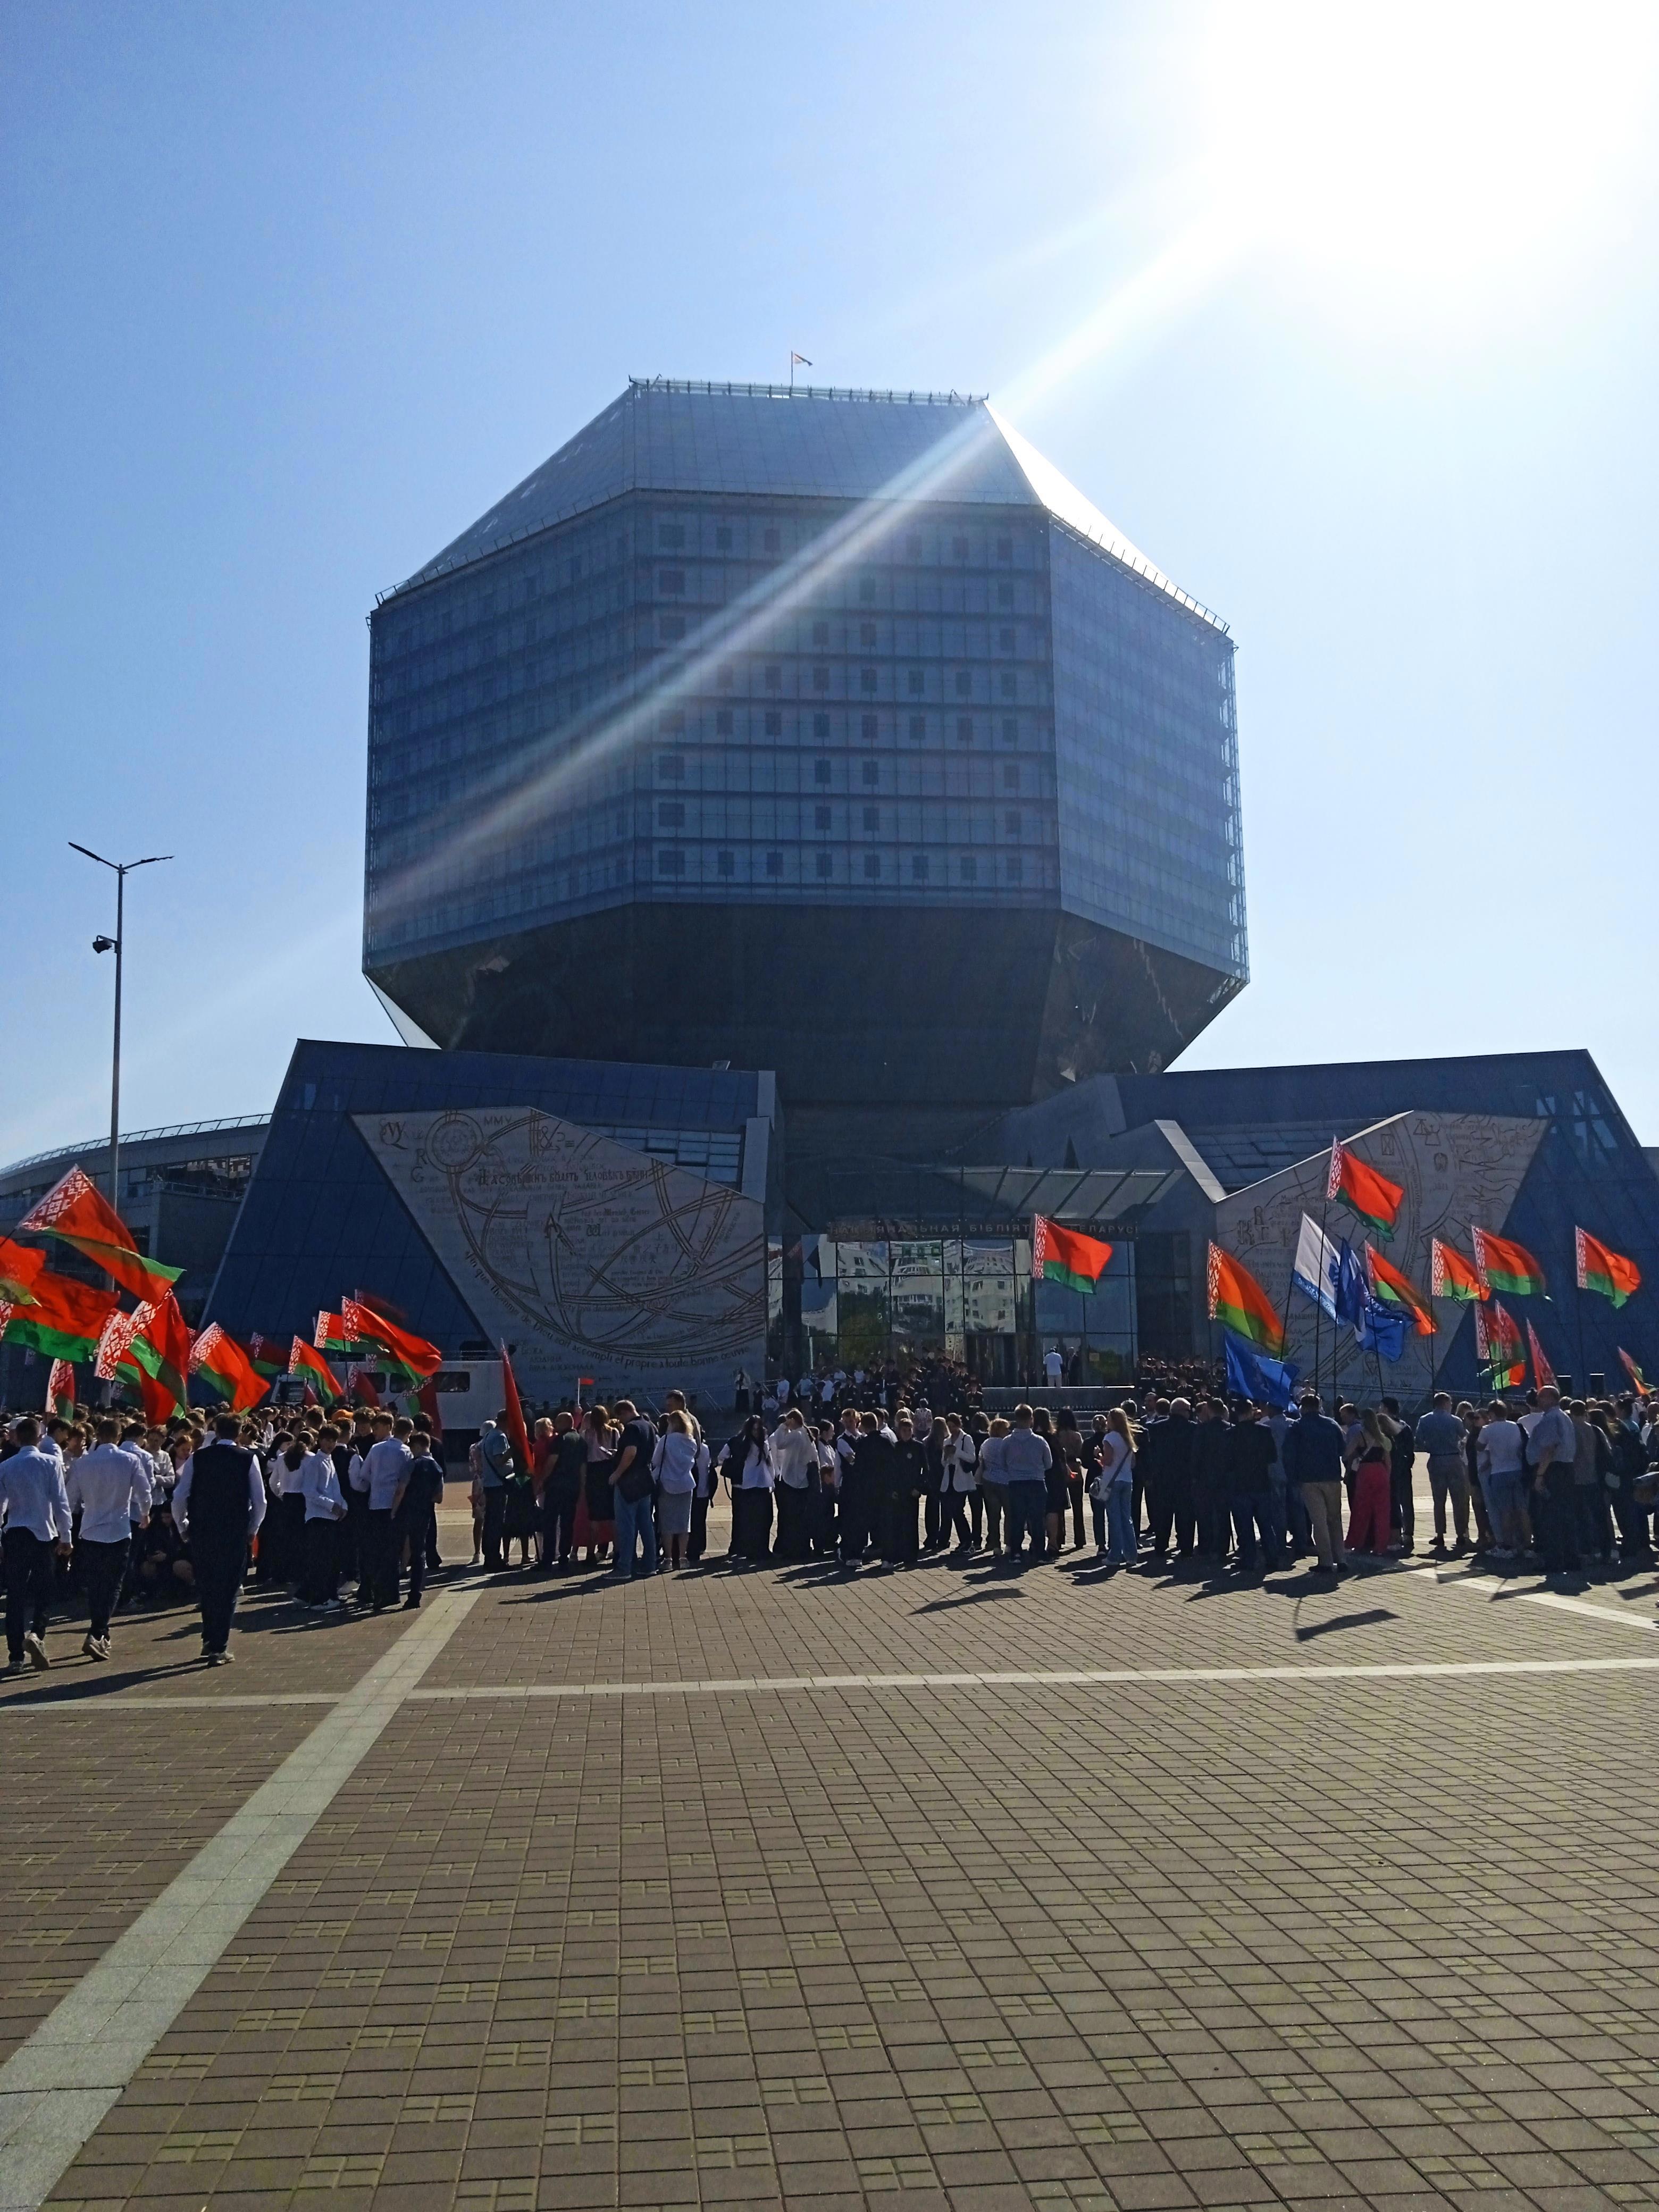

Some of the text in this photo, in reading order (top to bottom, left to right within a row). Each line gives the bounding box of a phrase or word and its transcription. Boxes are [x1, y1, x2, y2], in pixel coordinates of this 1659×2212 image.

[572, 1345, 613, 1363] accompli
[625, 1359, 657, 1370] propre
[690, 1356, 718, 1366] bonne
